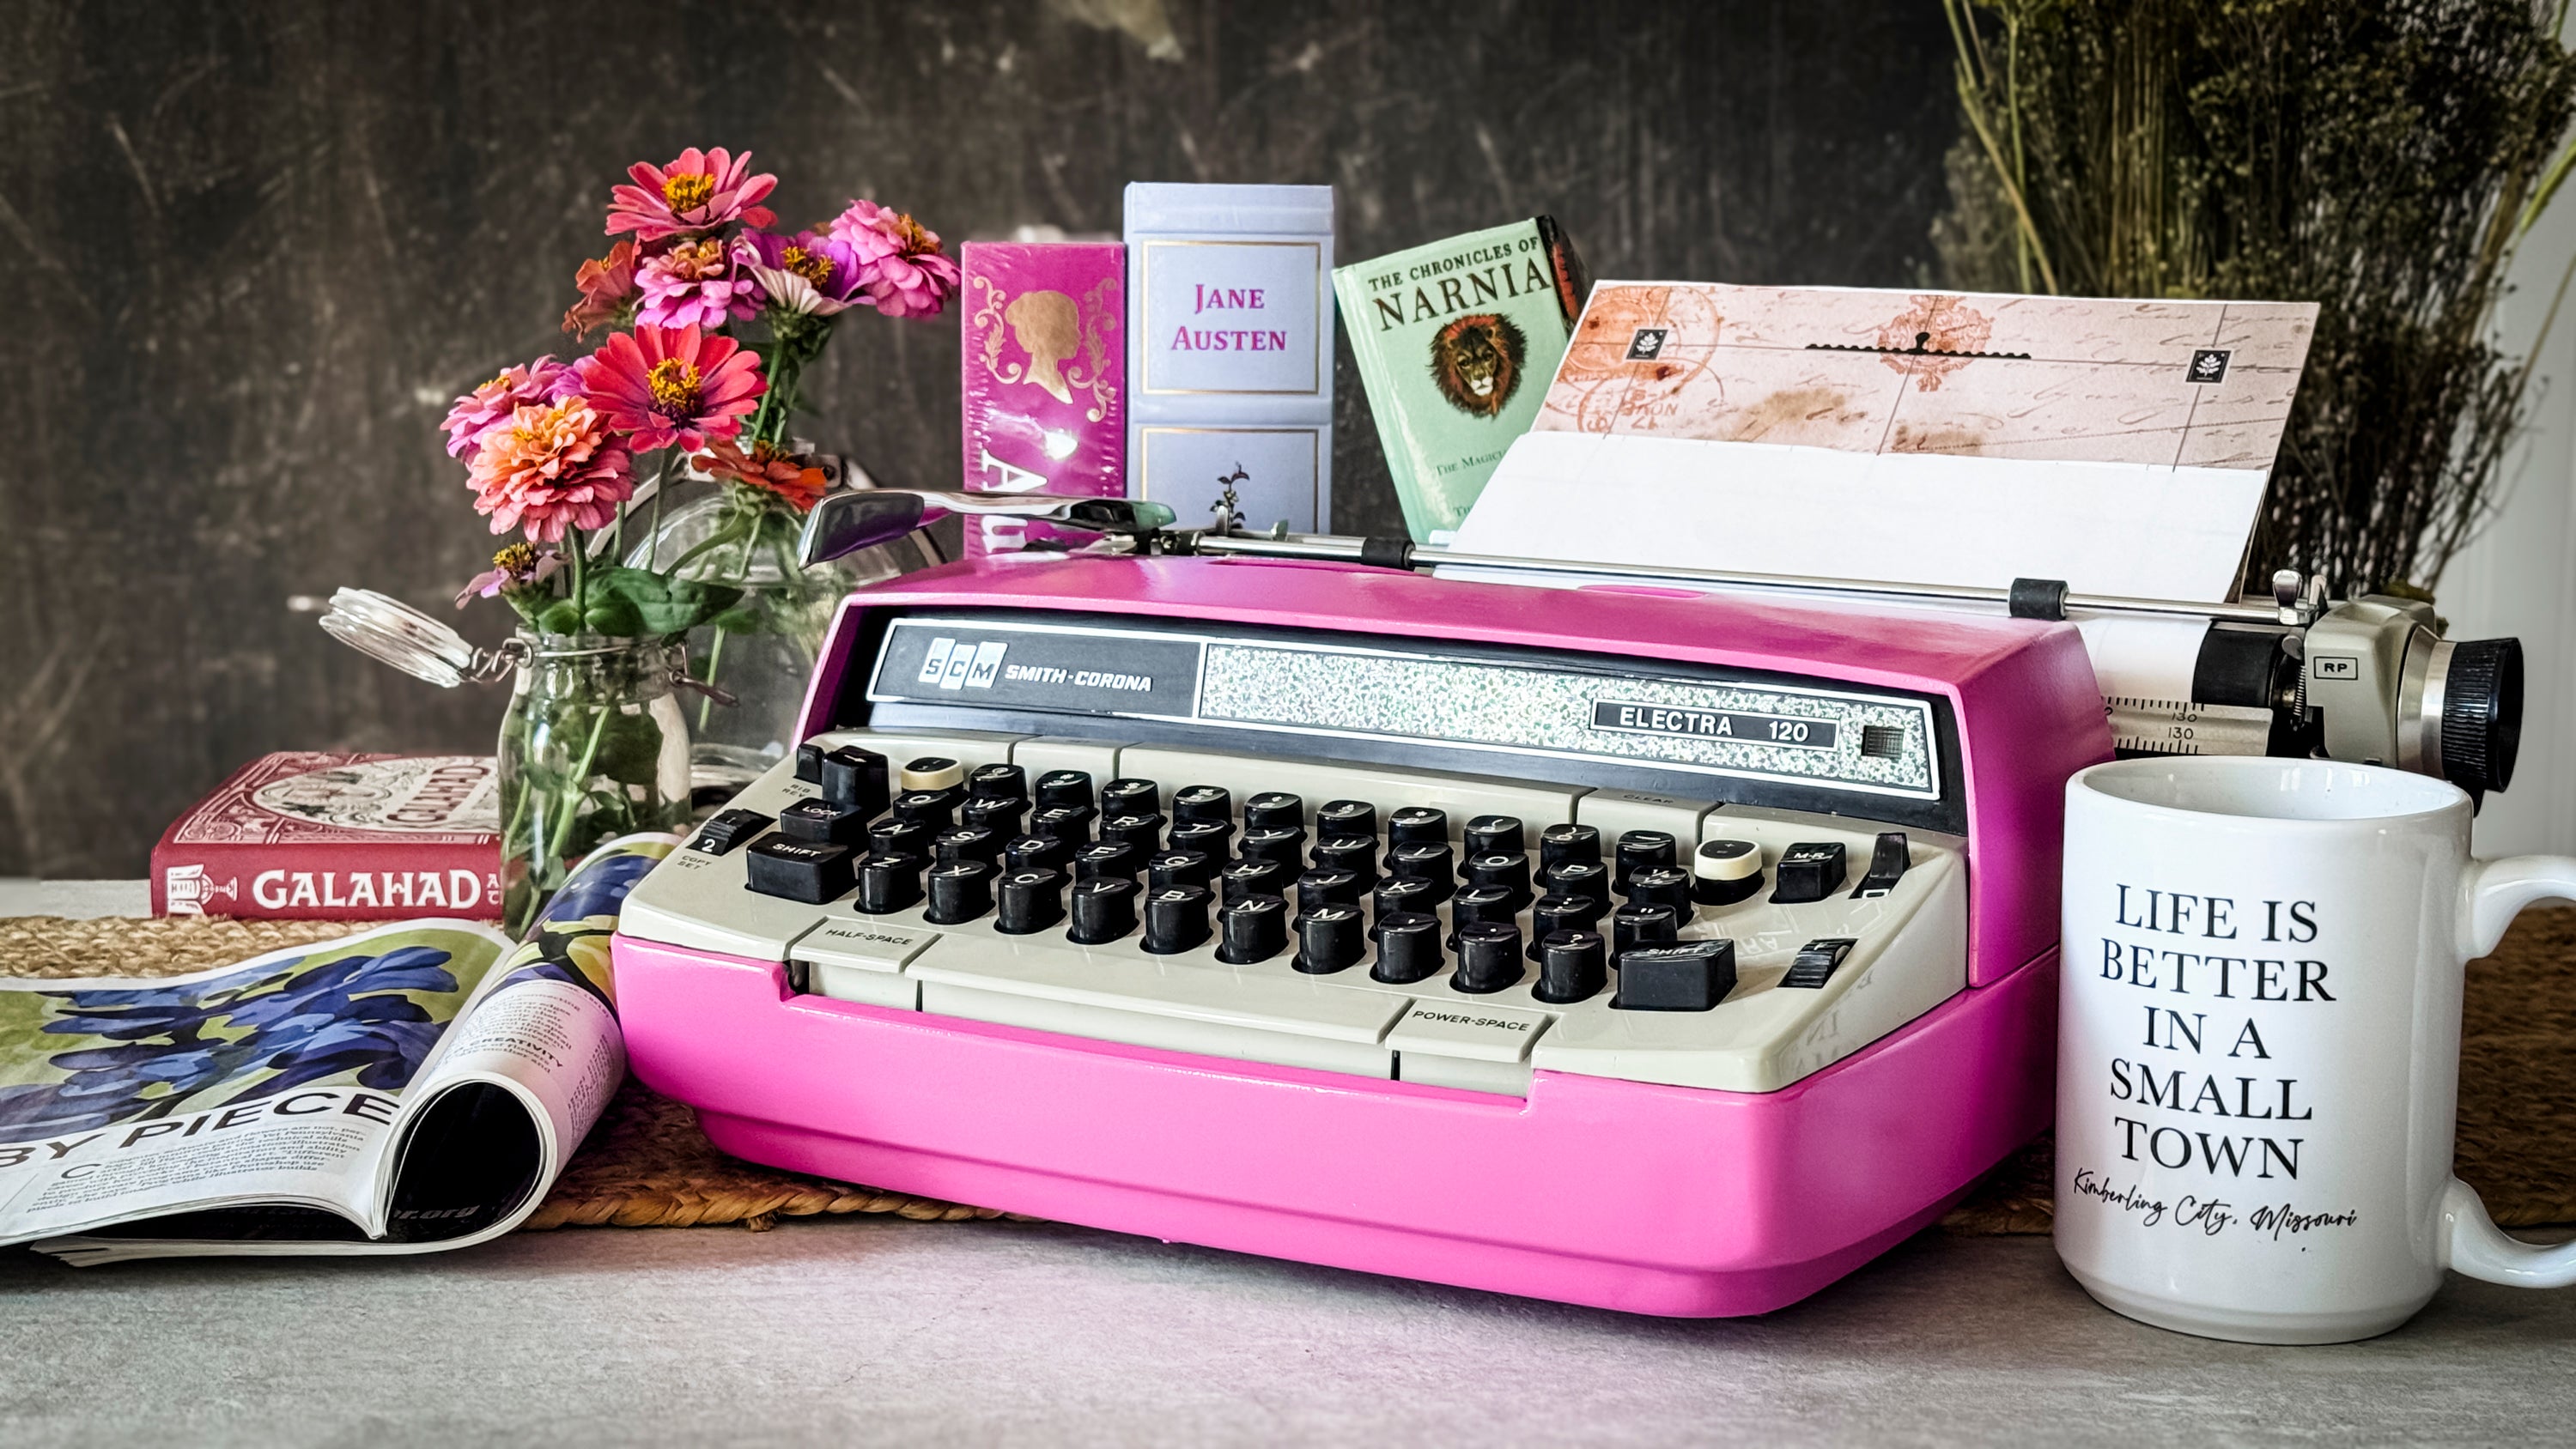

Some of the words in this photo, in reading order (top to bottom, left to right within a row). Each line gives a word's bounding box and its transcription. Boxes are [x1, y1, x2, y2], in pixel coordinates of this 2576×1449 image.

[1368, 272, 1403, 292] THE
[1409, 243, 1512, 282] CHRONICLES
[1518, 236, 1540, 252] OF
[1194, 283, 1266, 314] JANE
[1372, 257, 1552, 331] NARNIA
[1171, 326, 1287, 351] AUSTEN
[926, 659, 995, 681] SCM
[2324, 663, 2348, 673] RP
[2172, 712, 2197, 723] 130
[1620, 706, 1734, 736] ELECTRA
[1769, 721, 1809, 743] 120
[2167, 727, 2194, 740] 130
[908, 794, 932, 804] Q
[975, 798, 1008, 809] W
[802, 806, 841, 816] LOCK
[1043, 809, 1071, 818] E
[1113, 816, 1139, 826] R
[881, 823, 904, 834] A
[1192, 823, 1211, 833] T
[951, 832, 975, 841] S
[1263, 829, 1284, 839] Y
[702, 840, 715, 852] 2
[1018, 840, 1045, 850] D
[1332, 839, 1358, 848] U
[773, 842, 822, 858] SHIFT
[1091, 846, 1117, 856] F
[677, 861, 702, 870] SET
[682, 855, 712, 866] COPY
[872, 857, 901, 868] Z
[1164, 856, 1189, 867] G
[943, 865, 970, 876] X
[1235, 864, 1264, 875] H
[1562, 864, 1588, 874] P
[1014, 874, 1039, 883] C
[1315, 875, 1338, 884] J
[252, 869, 481, 910] GALAHAD
[1092, 882, 1115, 893] V
[1388, 882, 1415, 892] K
[1159, 890, 1185, 900] B
[1467, 889, 1480, 899] L
[1236, 900, 1265, 911] N
[1312, 908, 1346, 919] M
[2115, 883, 2238, 940] LIFE
[2261, 900, 2318, 943] IS
[825, 929, 914, 945] HALF-SPACE
[1647, 947, 1700, 956] SHIFT
[2099, 937, 2337, 1002] BETTER
[1413, 1011, 1530, 1032] POWER-SPACE
[2142, 1005, 2208, 1054] IN
[2227, 1017, 2272, 1059] A
[471, 1037, 563, 1067] CREATIVITY
[2111, 1058, 2312, 1120] SMALL
[0, 1133, 106, 1168] BY
[118, 1092, 400, 1149] PIECE
[2114, 1116, 2305, 1180] TOWN
[2074, 1167, 2168, 1227] Kimberling
[2250, 1203, 2359, 1241] Missouri
